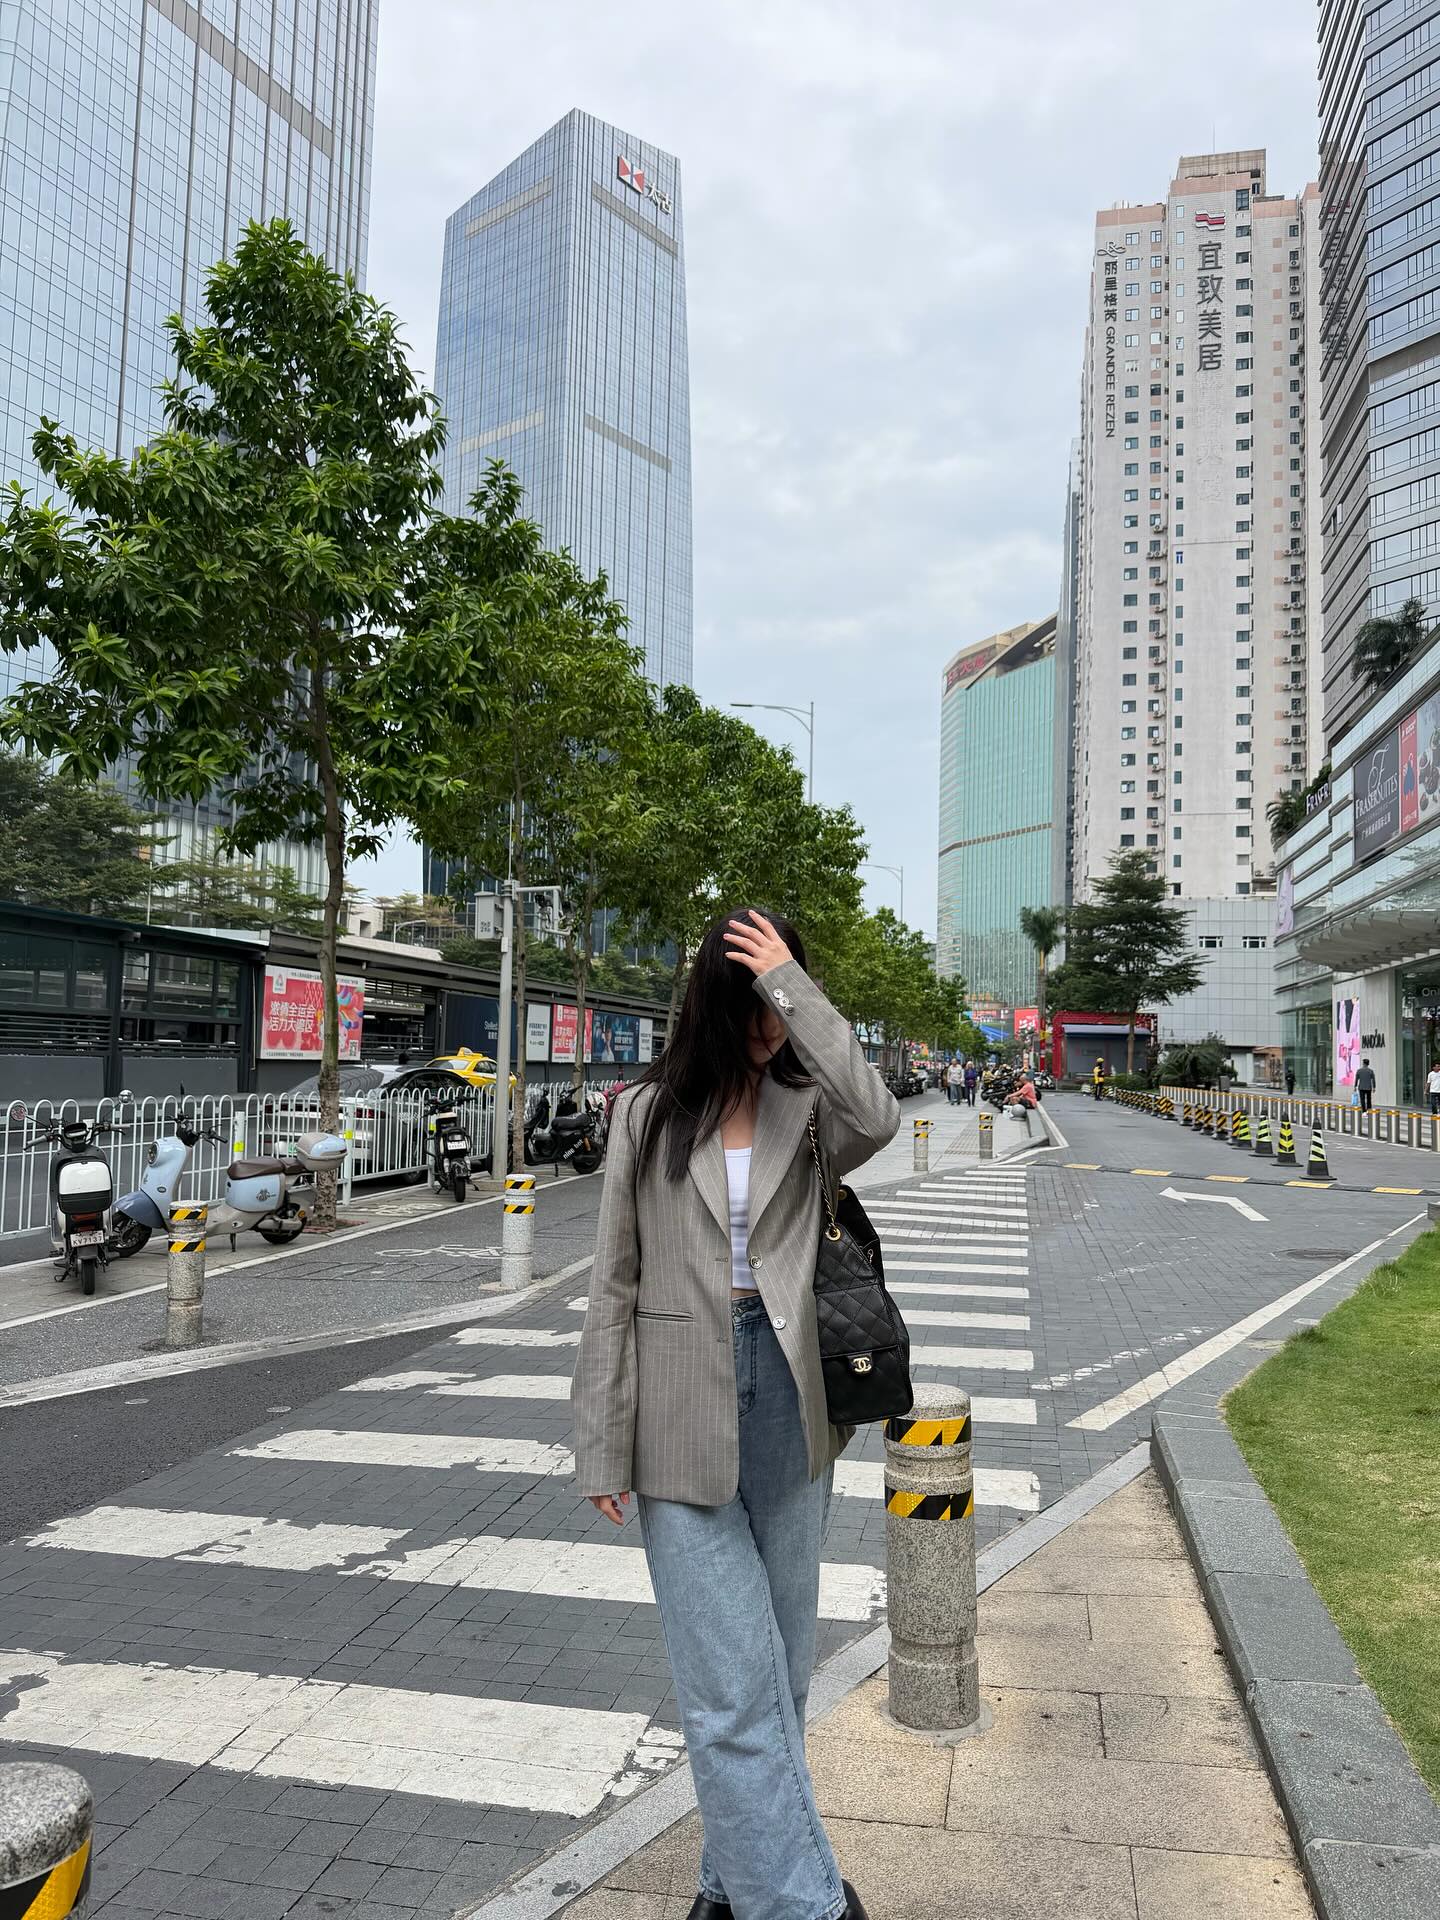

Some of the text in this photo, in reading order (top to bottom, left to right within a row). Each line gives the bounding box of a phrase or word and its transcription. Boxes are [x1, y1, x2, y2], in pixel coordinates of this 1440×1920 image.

[1197, 240, 1224, 372] 宜致美居
[1105, 326, 1116, 391] GRANDEE
[1105, 394, 1116, 439] REZEN
